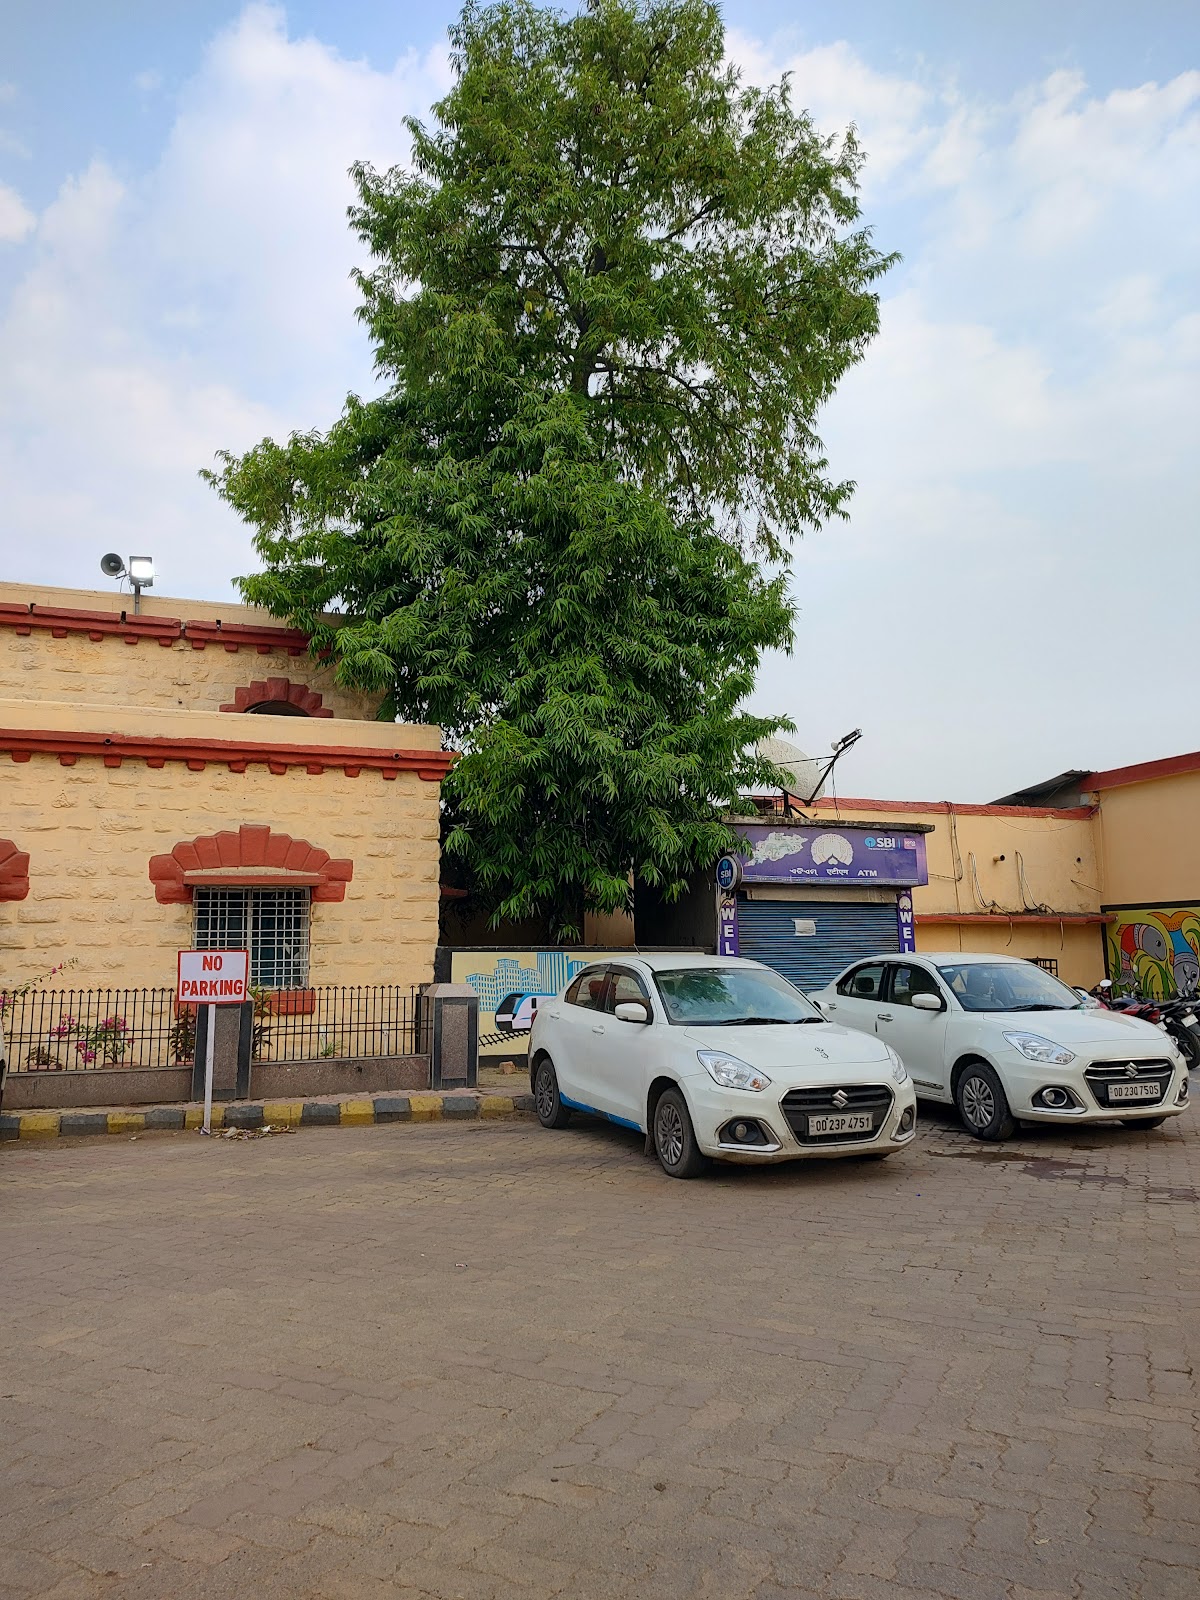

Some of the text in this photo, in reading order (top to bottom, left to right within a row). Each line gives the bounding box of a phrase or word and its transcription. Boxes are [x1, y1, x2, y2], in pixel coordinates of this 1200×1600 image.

[876, 837, 896, 848] SBI
[720, 869, 732, 878] SBI
[826, 867, 849, 876] एटीएम
[857, 869, 878, 877] ATM
[721, 877, 731, 885] ATM
[202, 955, 223, 971] NO
[181, 979, 243, 997] PARKING
[1113, 1087, 1123, 1097] OD
[1139, 1085, 1159, 1096] 7505
[816, 1117, 870, 1132] OD 23P 4751
